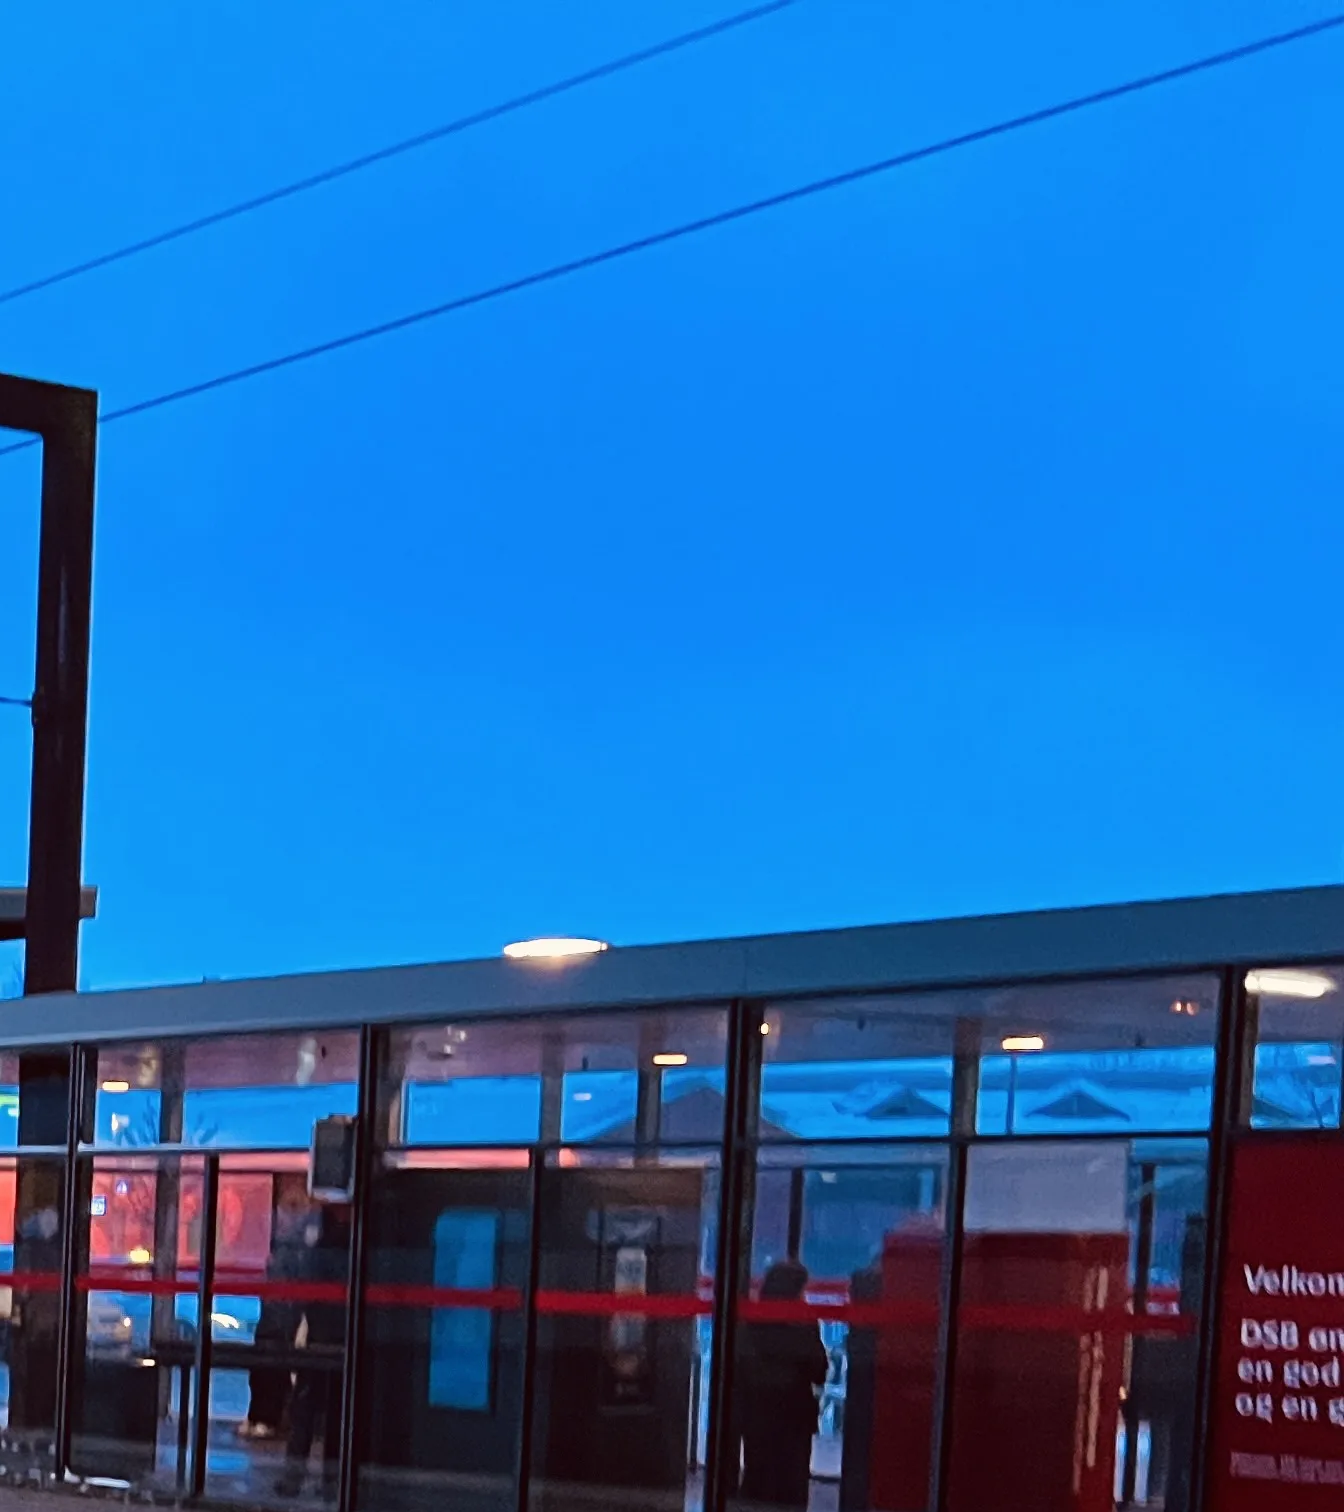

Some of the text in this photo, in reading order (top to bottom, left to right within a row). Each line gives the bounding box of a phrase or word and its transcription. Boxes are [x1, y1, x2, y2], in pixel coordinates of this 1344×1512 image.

[1240, 1318, 1299, 1351] DSB
[1237, 1356, 1341, 1389] en god
[1235, 1392, 1272, 1424] og
[1281, 1395, 1318, 1421] en
